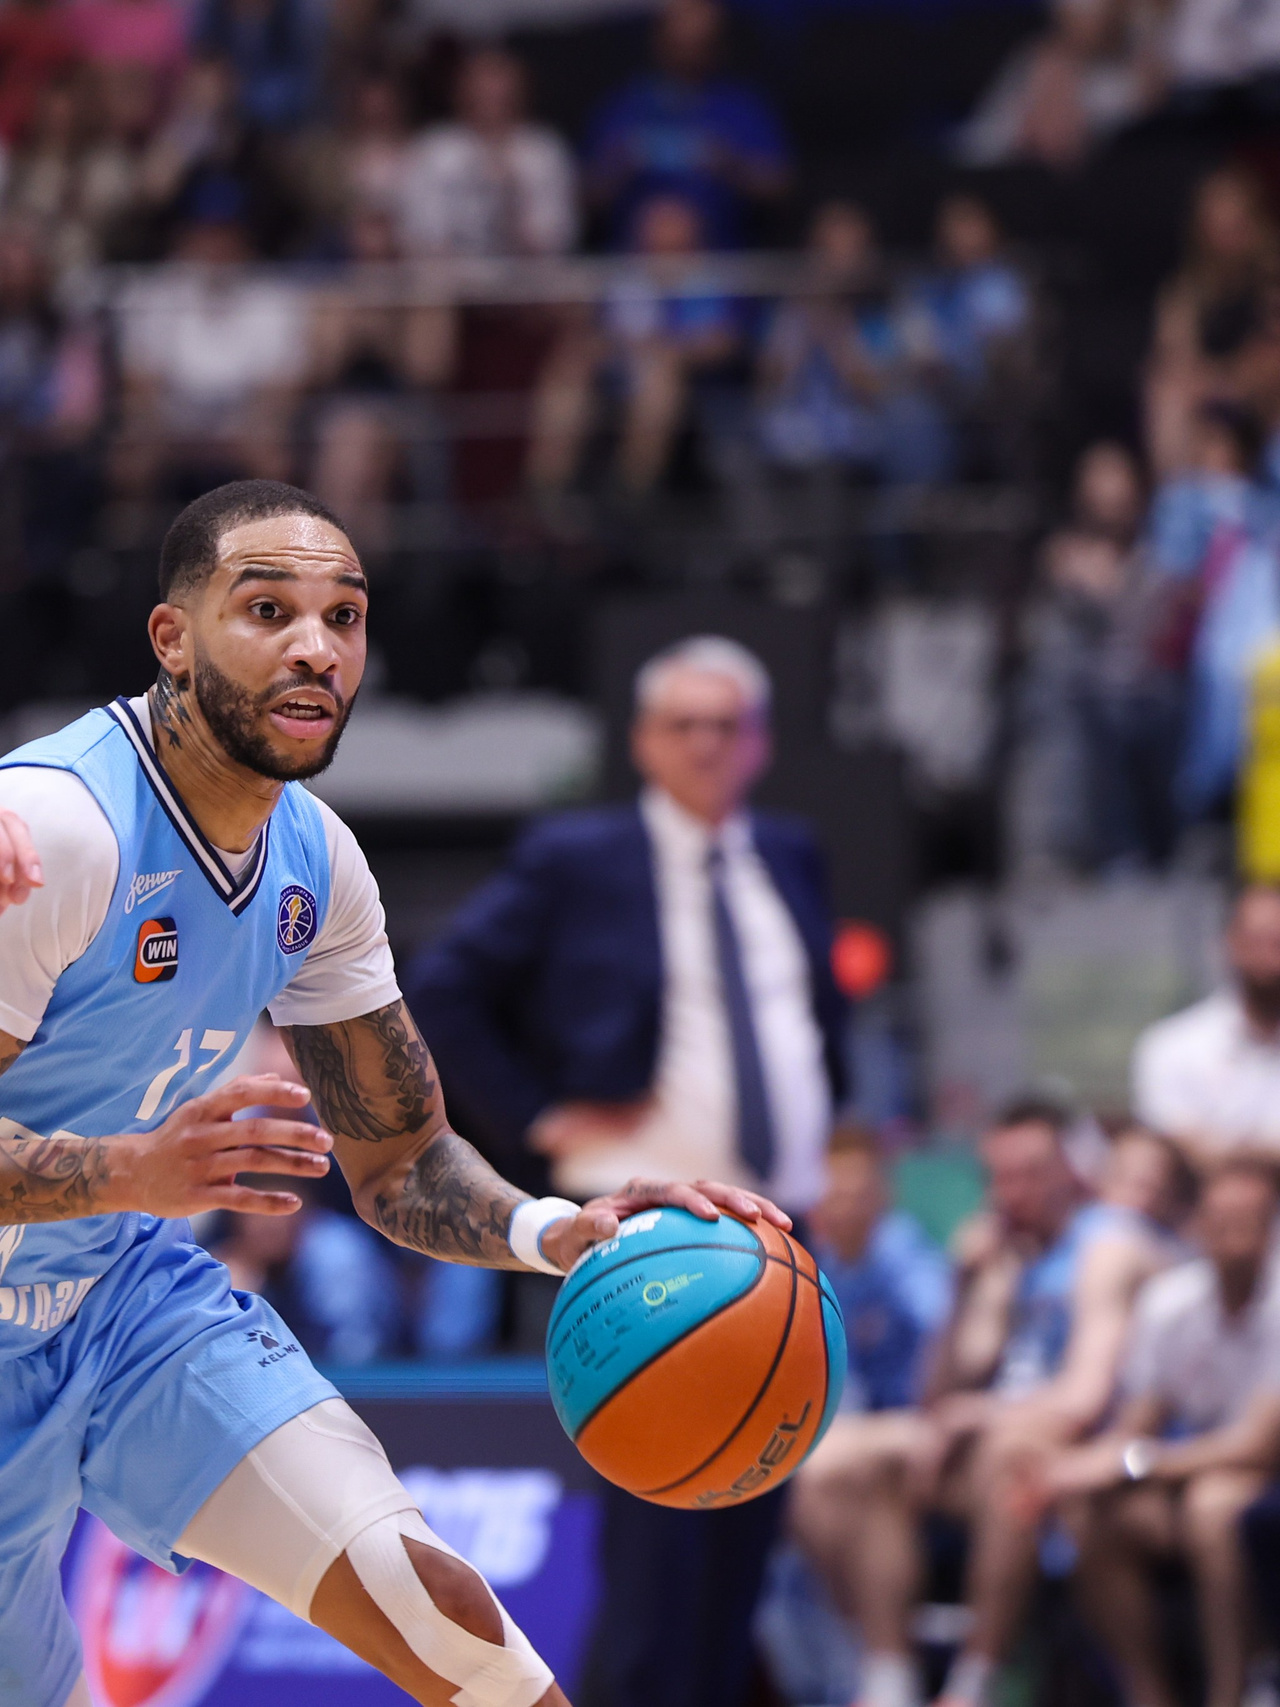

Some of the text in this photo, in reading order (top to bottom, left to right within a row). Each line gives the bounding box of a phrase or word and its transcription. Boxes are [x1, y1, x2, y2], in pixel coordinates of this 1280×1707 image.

[148, 940, 177, 960] WIN
[135, 1028, 236, 1121] 17
[257, 1344, 299, 1367] KELME
